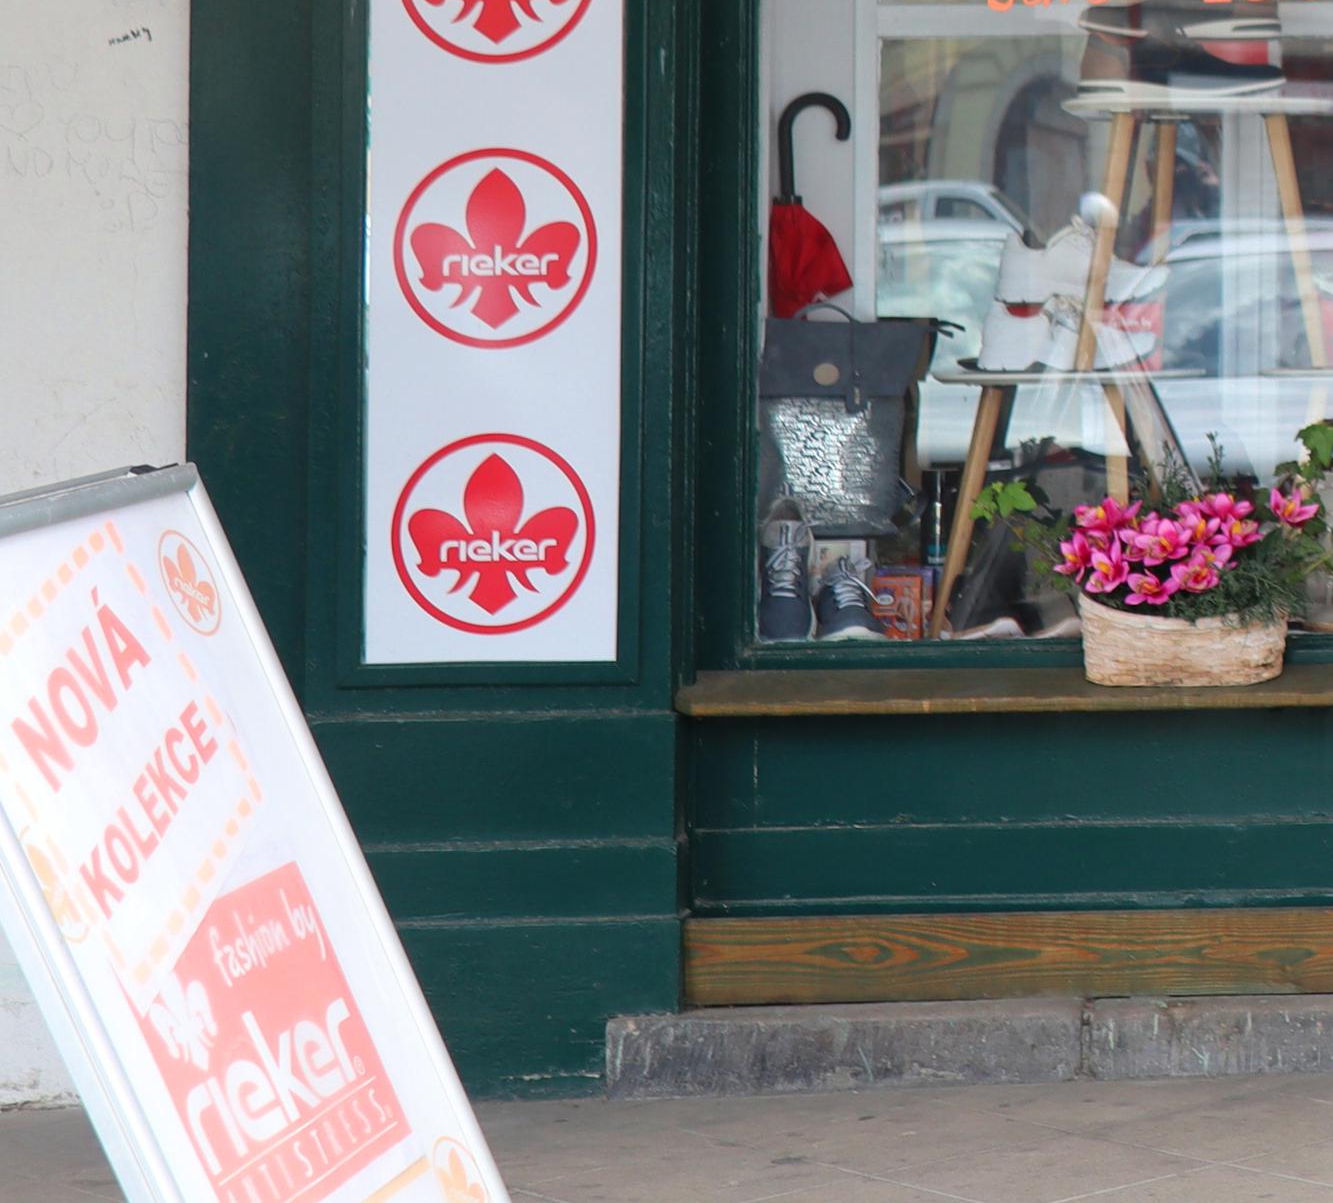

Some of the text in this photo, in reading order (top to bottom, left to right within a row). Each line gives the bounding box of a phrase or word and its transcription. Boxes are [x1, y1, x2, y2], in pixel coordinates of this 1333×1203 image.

[442, 245, 559, 277] rieker
[440, 530, 557, 563] rieker
[12, 587, 153, 794] NOVÁ
[79, 702, 218, 921] KOLEKCE
[208, 888, 327, 988] fashion by
[186, 998, 352, 1177] rieker
